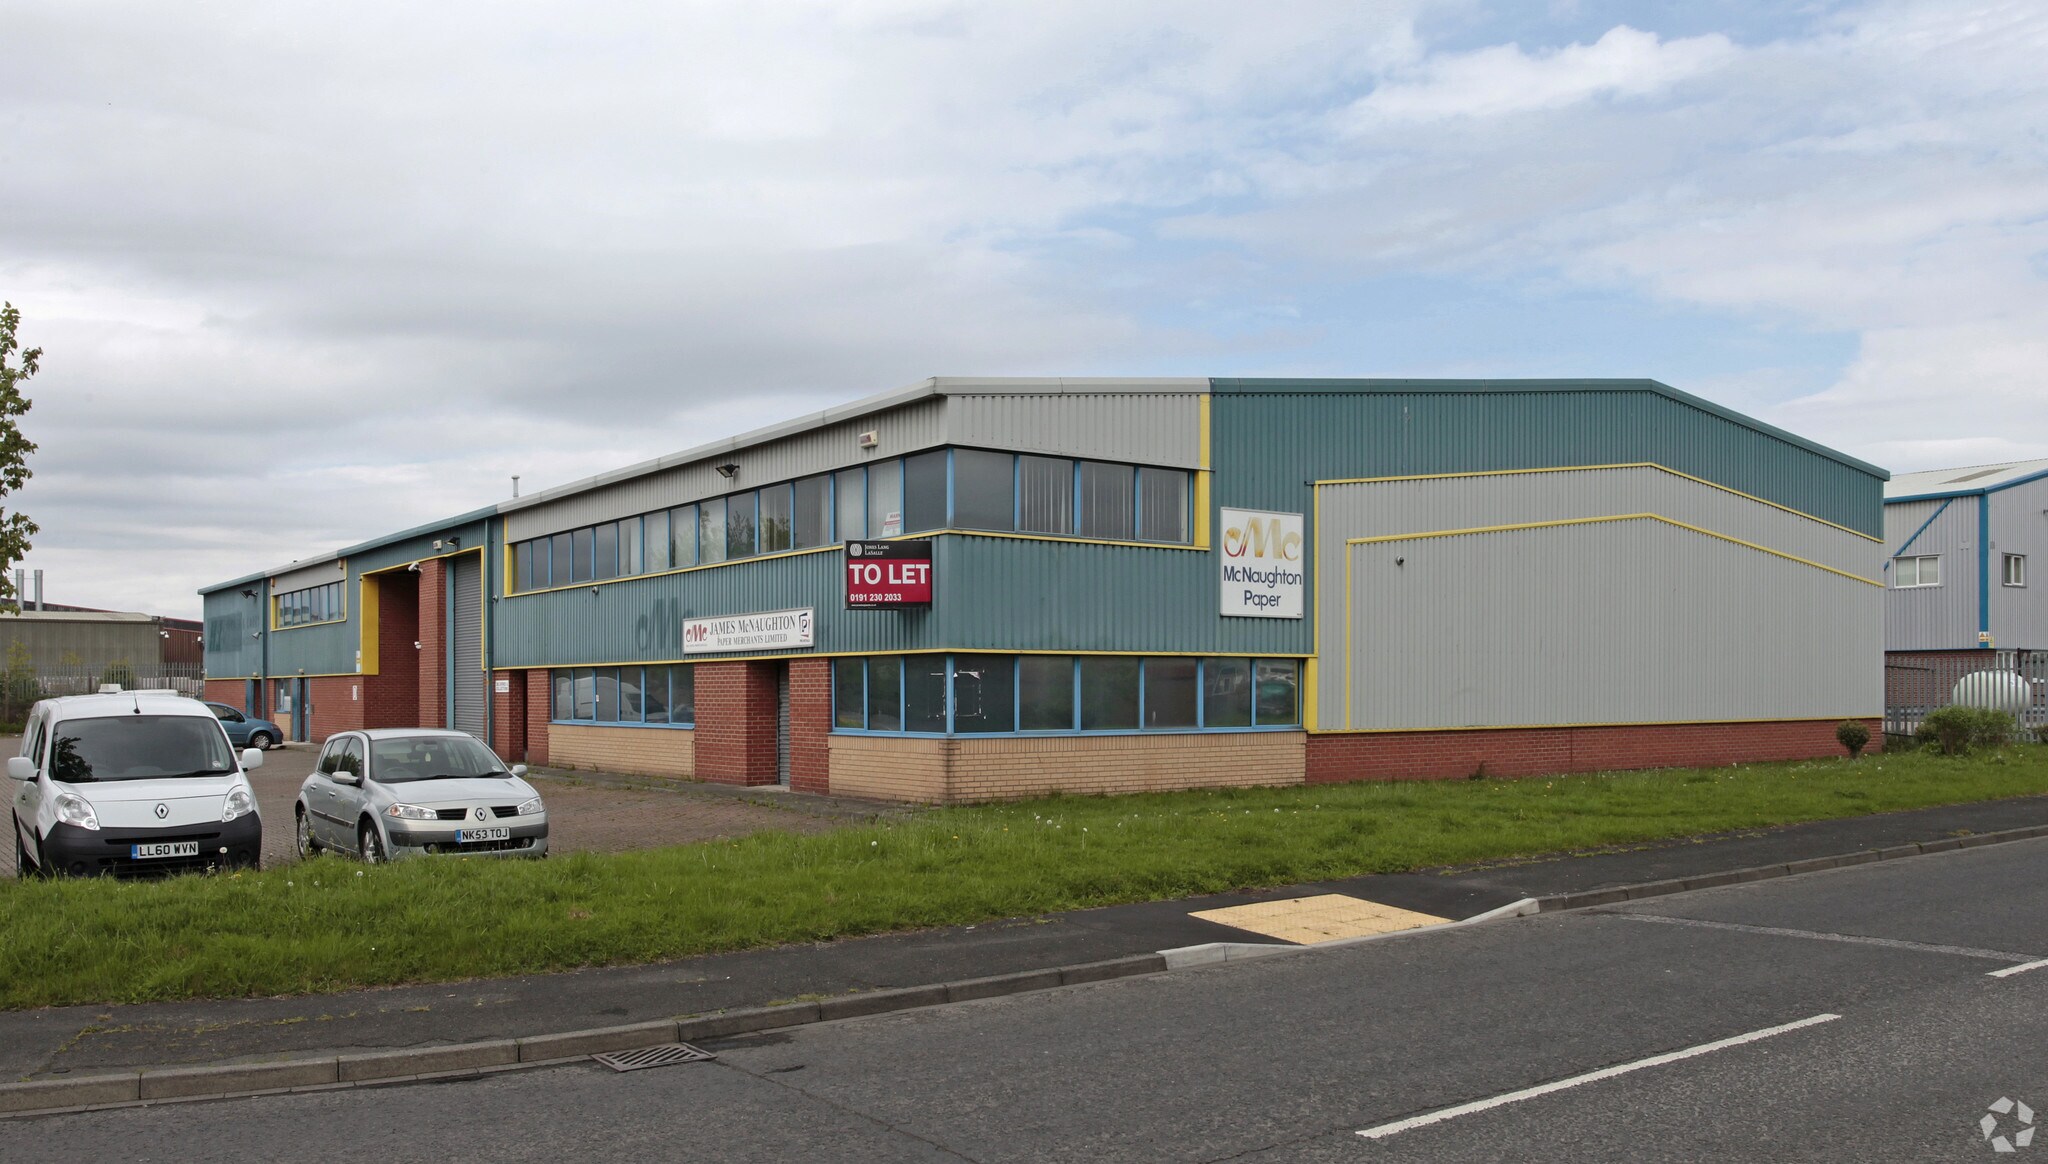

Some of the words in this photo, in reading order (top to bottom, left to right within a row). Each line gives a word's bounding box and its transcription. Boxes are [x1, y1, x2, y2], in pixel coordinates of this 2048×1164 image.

[849, 563, 882, 585] TO
[888, 563, 930, 585] LET
[1223, 565, 1302, 589] McNaughton
[850, 593, 868, 601] 0191
[869, 593, 883, 601] 230
[884, 593, 902, 601] 2033
[1244, 589, 1282, 611] Paper
[709, 620, 736, 636] JAMES
[738, 615, 796, 634] McNAUGHTON
[717, 636, 732, 646] PAPER
[733, 635, 764, 646] MERCHANTS
[764, 633, 788, 644] LIMITED
[462, 830, 488, 840] NK53
[490, 828, 508, 838] TOJ
[139, 844, 171, 857] LL60
[173, 843, 197, 854] WVN
